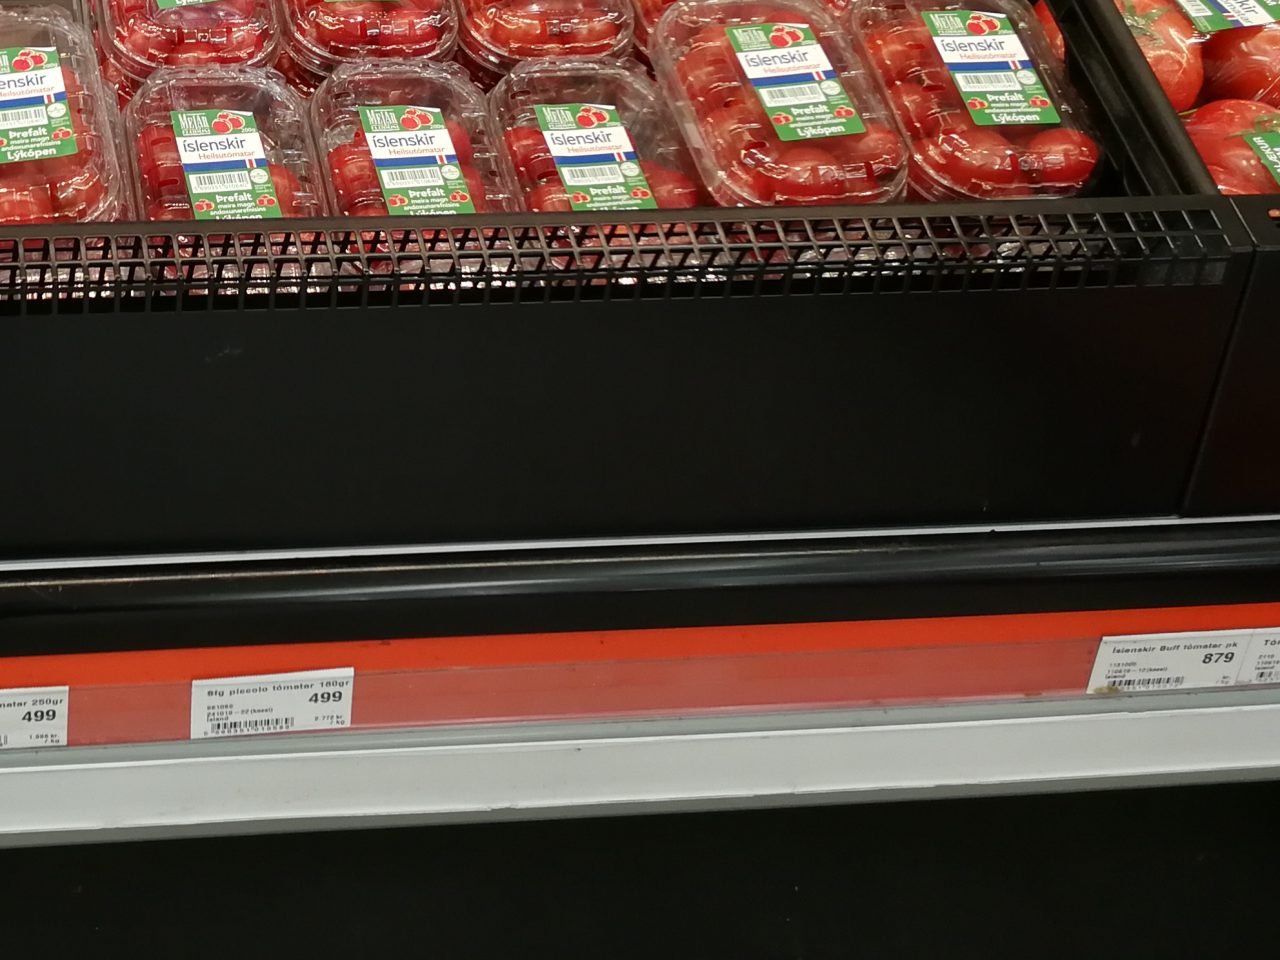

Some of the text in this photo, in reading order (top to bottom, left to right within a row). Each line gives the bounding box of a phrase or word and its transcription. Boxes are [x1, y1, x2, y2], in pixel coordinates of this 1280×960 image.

[940, 39, 1006, 52] íslenskir
[745, 51, 809, 68] íslenskir
[987, 93, 1024, 103] Þrefalt
[791, 105, 830, 115] Þrefalt
[992, 112, 1040, 123] Lýkópen
[8, 127, 47, 138] Þrefalt
[797, 124, 845, 138] Lýkópen
[373, 134, 435, 147] íslenskir
[551, 131, 613, 146] íslenskir
[183, 137, 246, 152] íslenskir
[7, 147, 56, 161] Lýkópen
[199, 151, 255, 160] Heilsutómatar
[216, 192, 252, 202] Þrefalt
[408, 188, 445, 197] Þrefalt
[1183, 642, 1222, 650] tómatar
[1202, 652, 1234, 664] 879
[273, 683, 314, 691] tómatar
[32, 698, 63, 706] 250gr
[309, 691, 342, 703] 499
[22, 709, 56, 722] 499
